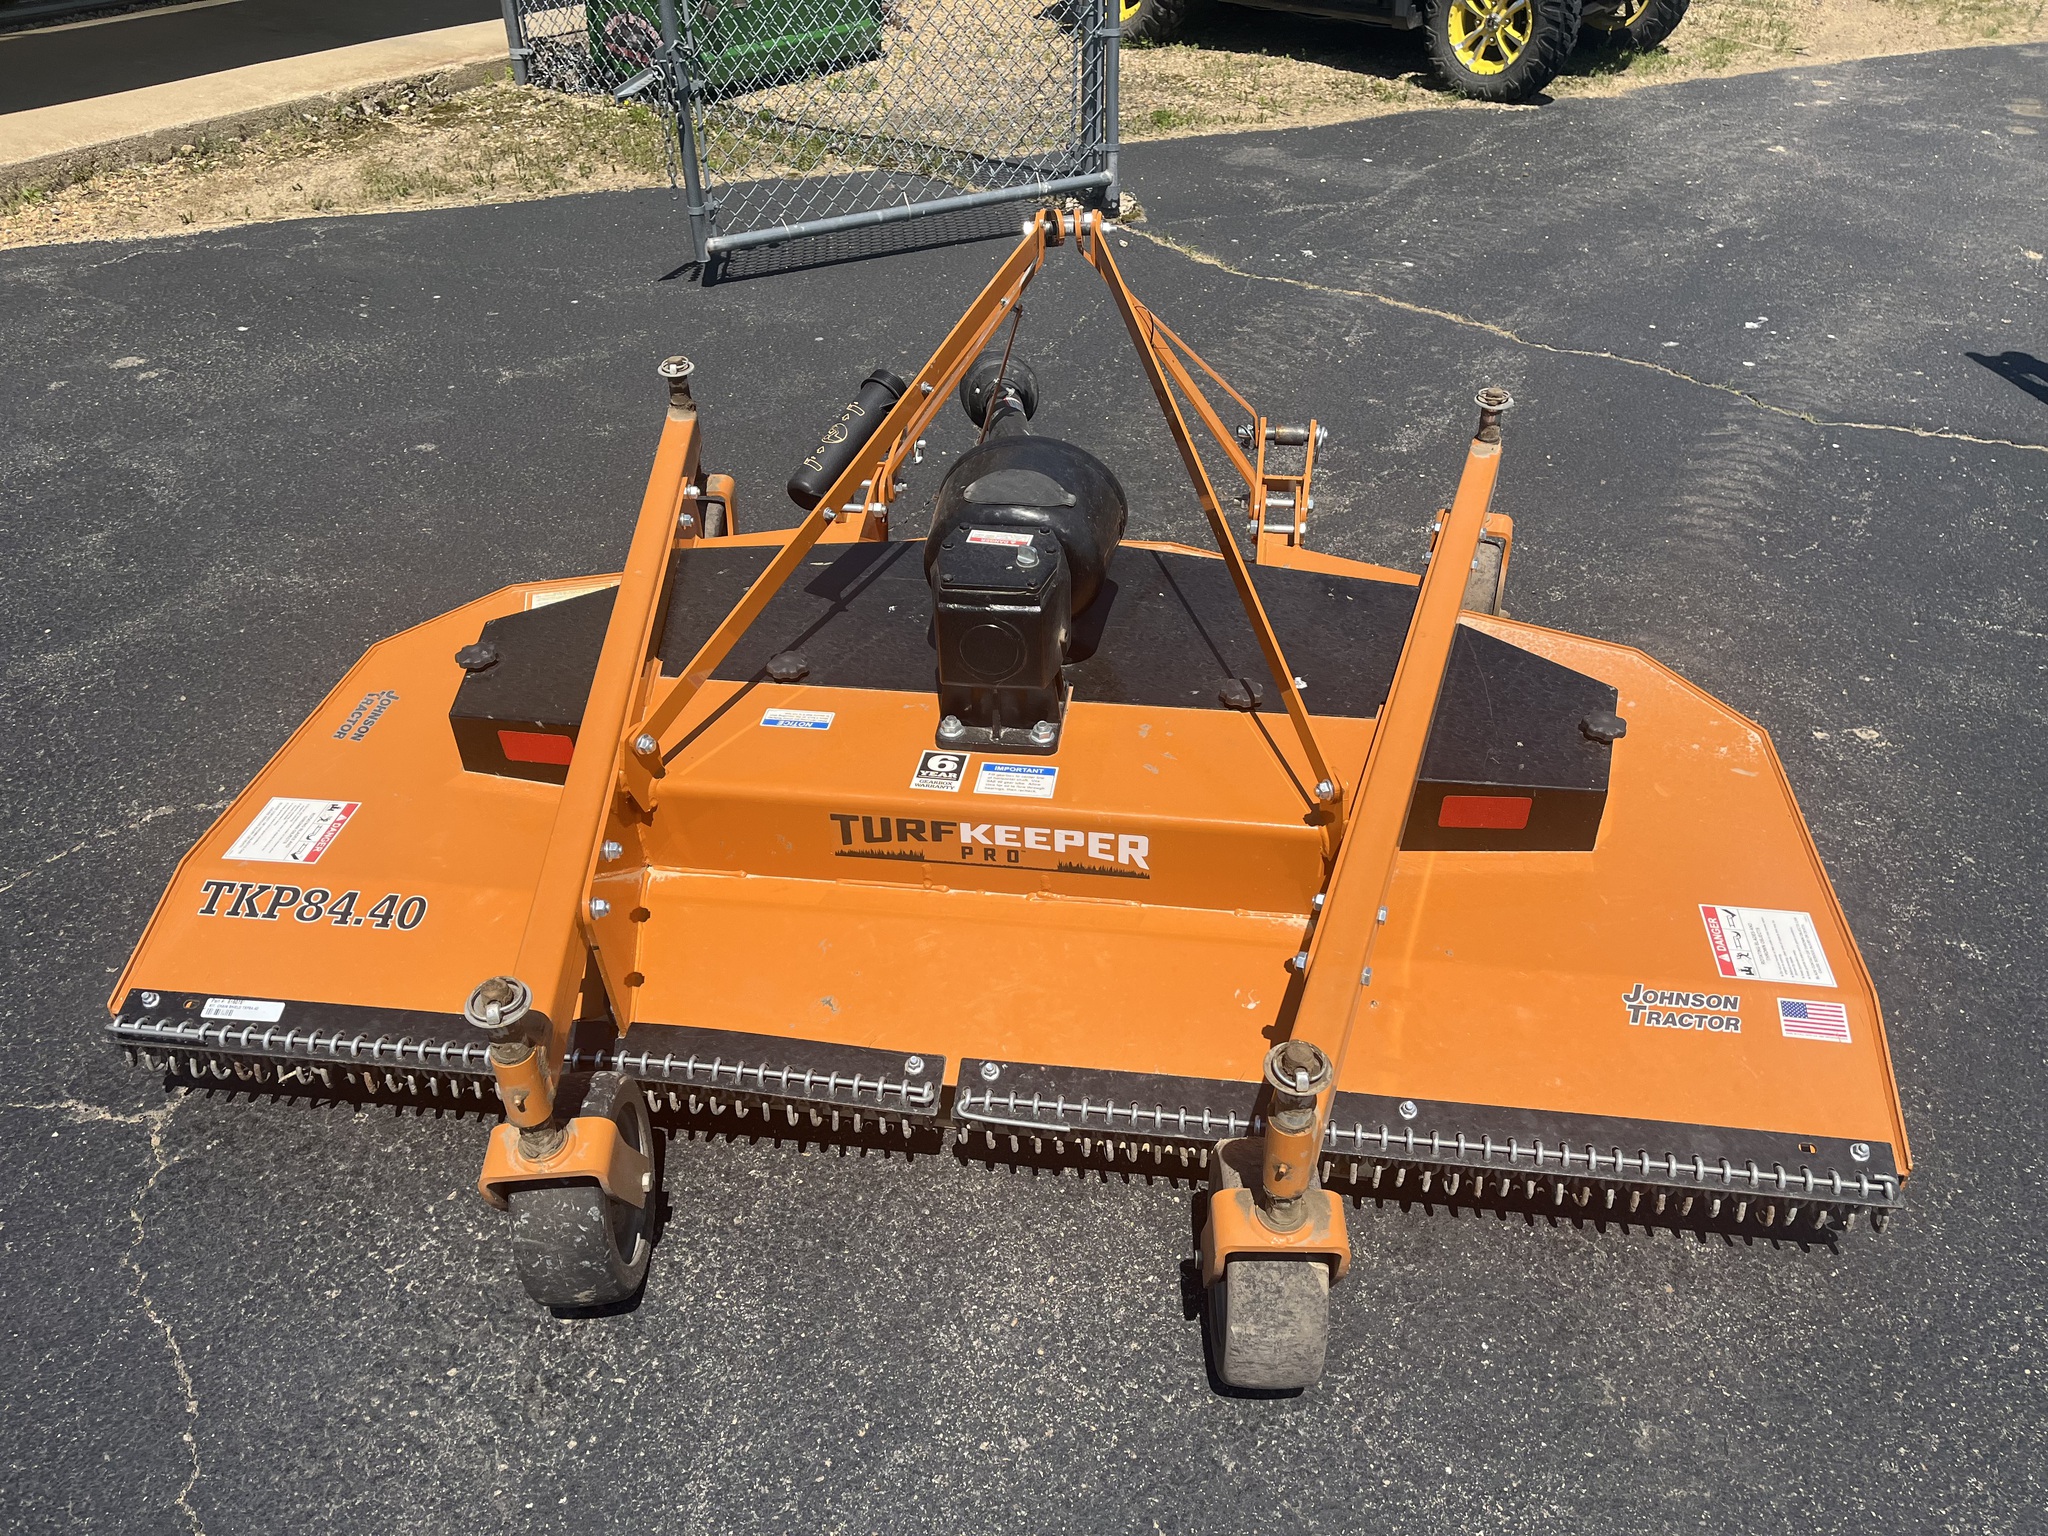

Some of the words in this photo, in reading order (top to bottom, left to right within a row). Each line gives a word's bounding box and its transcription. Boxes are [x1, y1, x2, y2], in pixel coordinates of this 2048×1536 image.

[333, 690, 386, 740] TRACTOR
[350, 690, 400, 741] JOHNSON
[919, 770, 958, 779] YEAR
[928, 754, 960, 772] 6
[994, 765, 1044, 774] IMPORTANT
[314, 822, 342, 852] DANGER
[830, 812, 1150, 870] TURFKEEPER
[961, 846, 1020, 864] PRO
[198, 880, 428, 930] TKP84.40
[1708, 917, 1726, 952] DANGER
[1622, 983, 1740, 1012] JOHNSON
[1626, 1004, 1741, 1034] TRACTOR
